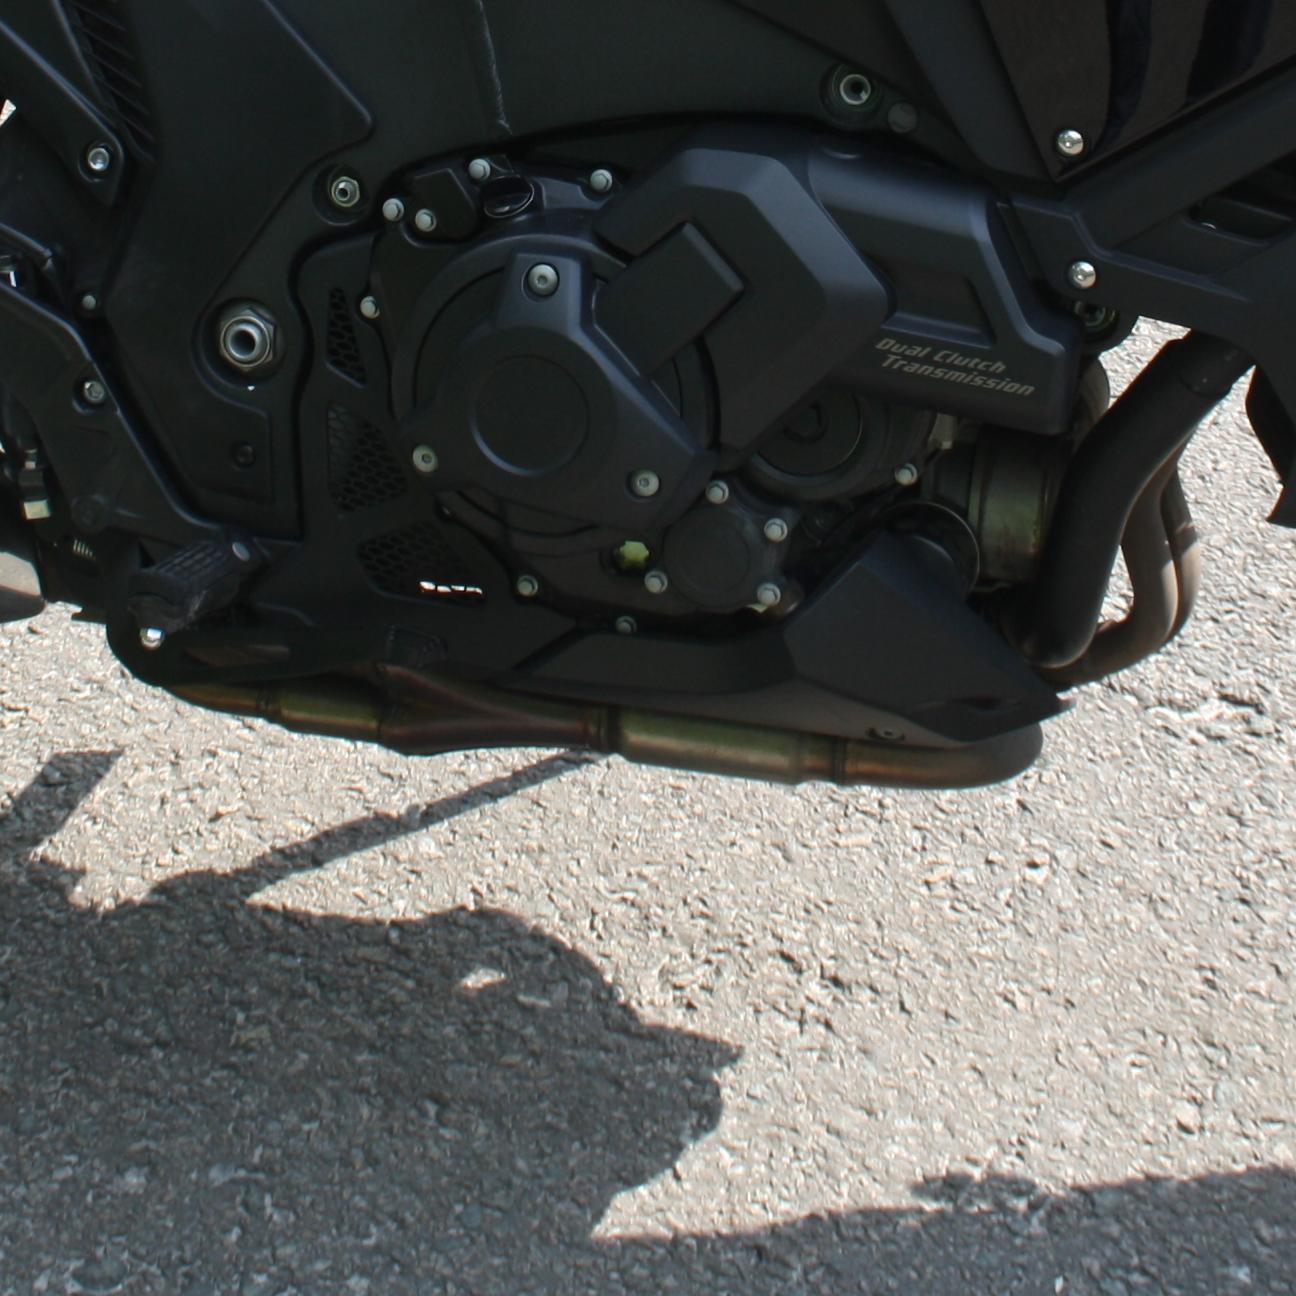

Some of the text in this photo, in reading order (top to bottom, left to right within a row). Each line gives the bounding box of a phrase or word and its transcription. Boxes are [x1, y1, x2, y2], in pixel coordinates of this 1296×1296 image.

[875, 337, 1007, 374] Dual Clutch
[881, 353, 1037, 396] Transmission
